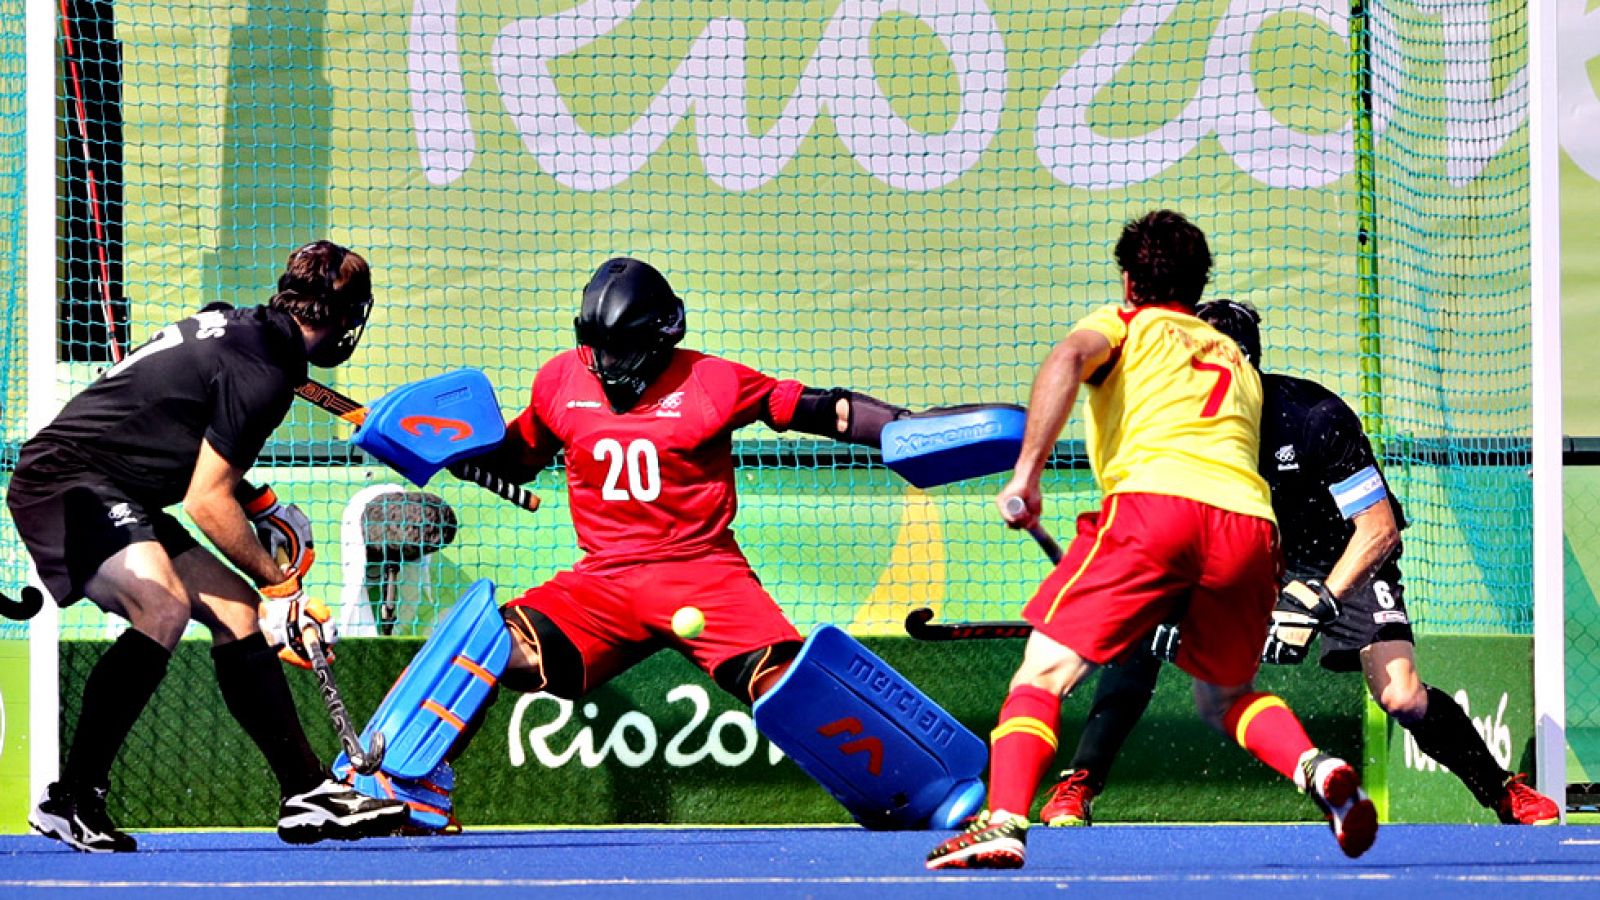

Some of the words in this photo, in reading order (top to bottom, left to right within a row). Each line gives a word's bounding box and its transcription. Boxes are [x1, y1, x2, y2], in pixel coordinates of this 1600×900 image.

[1191, 355, 1232, 419] 7
[593, 438, 661, 502] 20
[1373, 580, 1395, 609] 6
